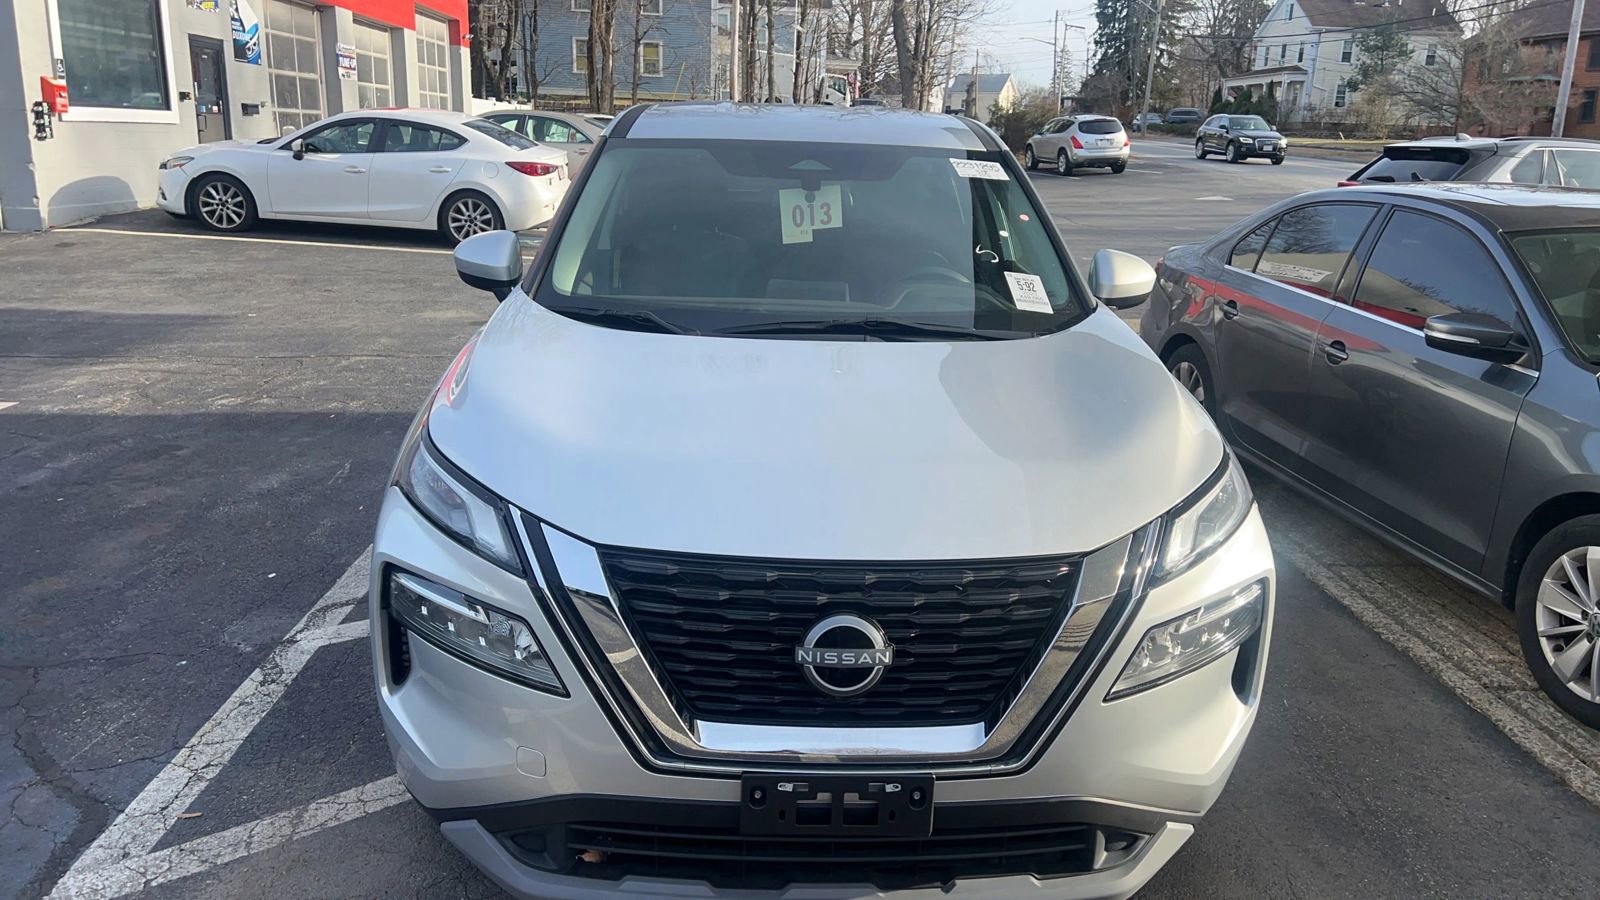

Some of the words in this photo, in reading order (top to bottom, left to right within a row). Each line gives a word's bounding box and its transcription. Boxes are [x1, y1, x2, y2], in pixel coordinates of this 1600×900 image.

[792, 202, 832, 228] 013
[1016, 280, 1037, 292] 5:92
[798, 649, 889, 664] NISSAN
